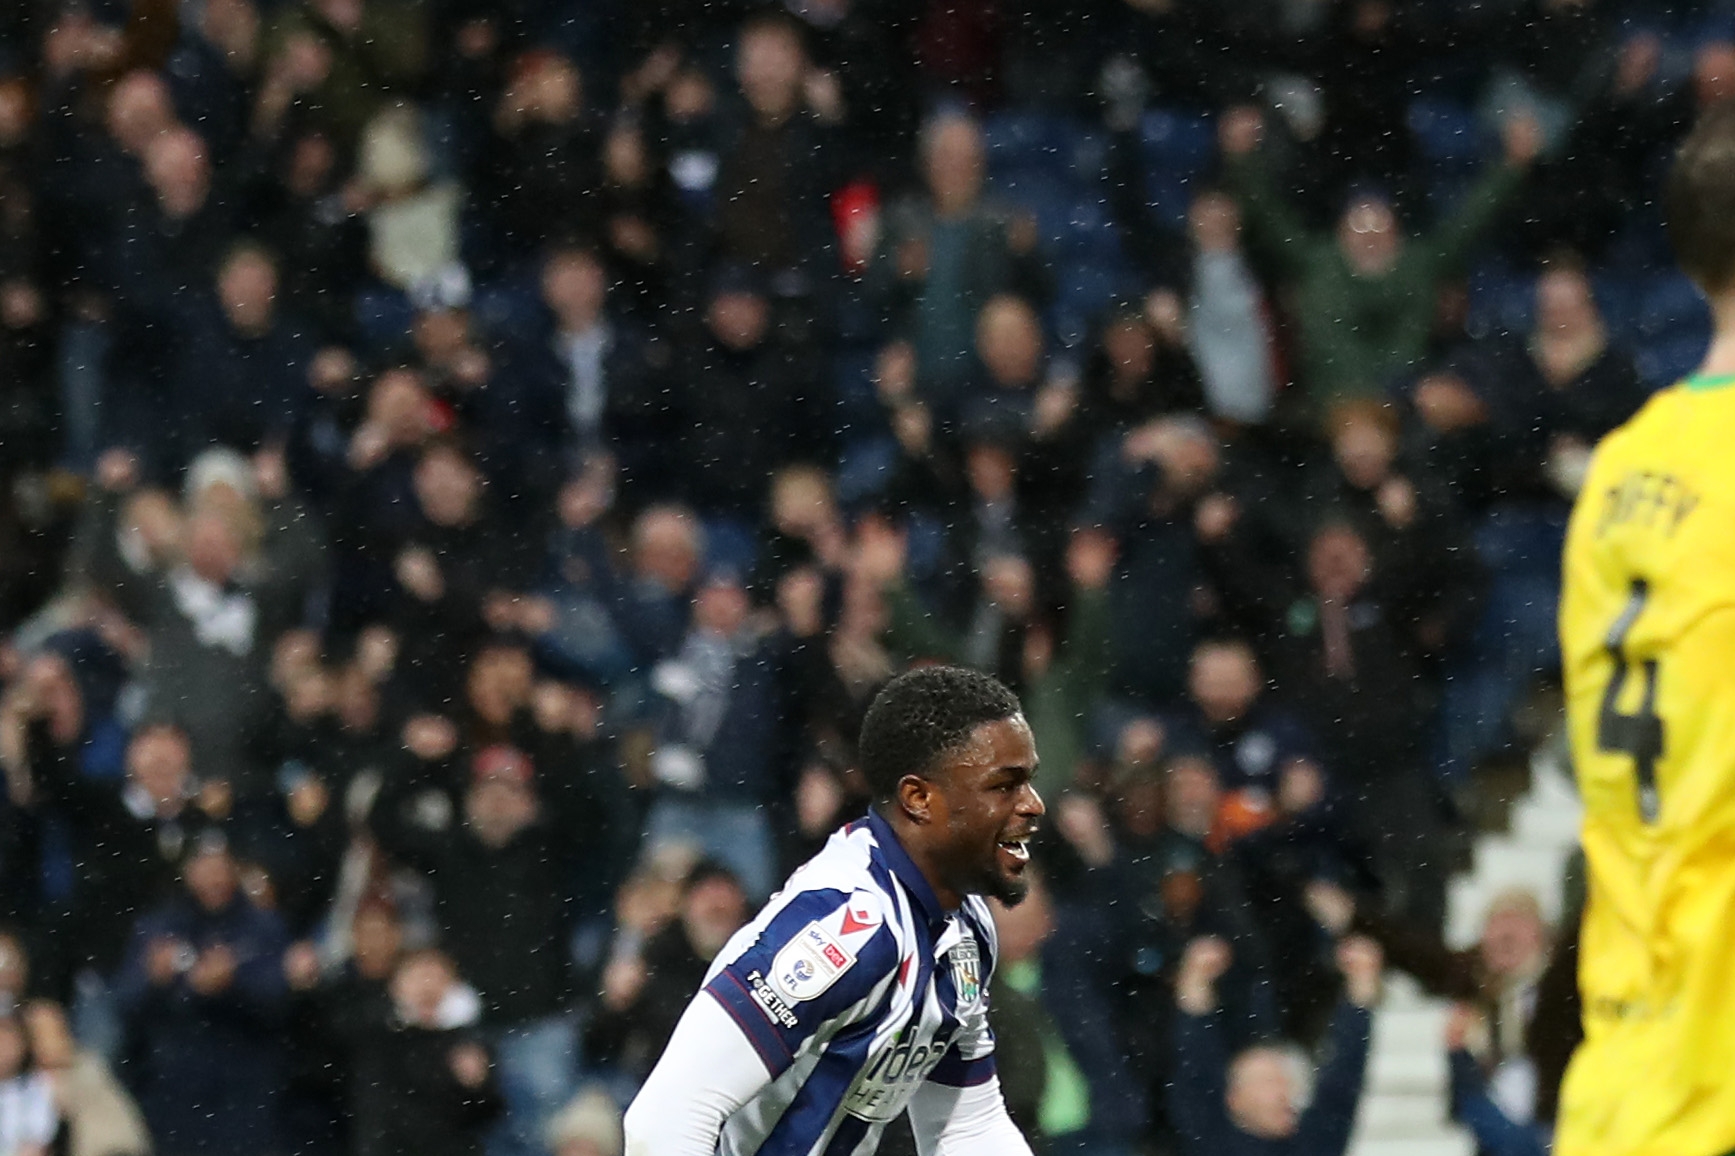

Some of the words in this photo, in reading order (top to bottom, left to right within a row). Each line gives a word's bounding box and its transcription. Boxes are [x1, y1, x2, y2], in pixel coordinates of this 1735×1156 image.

[1597, 574, 1666, 824] 4
[746, 970, 799, 1029] TOGETHER
[783, 974, 799, 992] EFL
